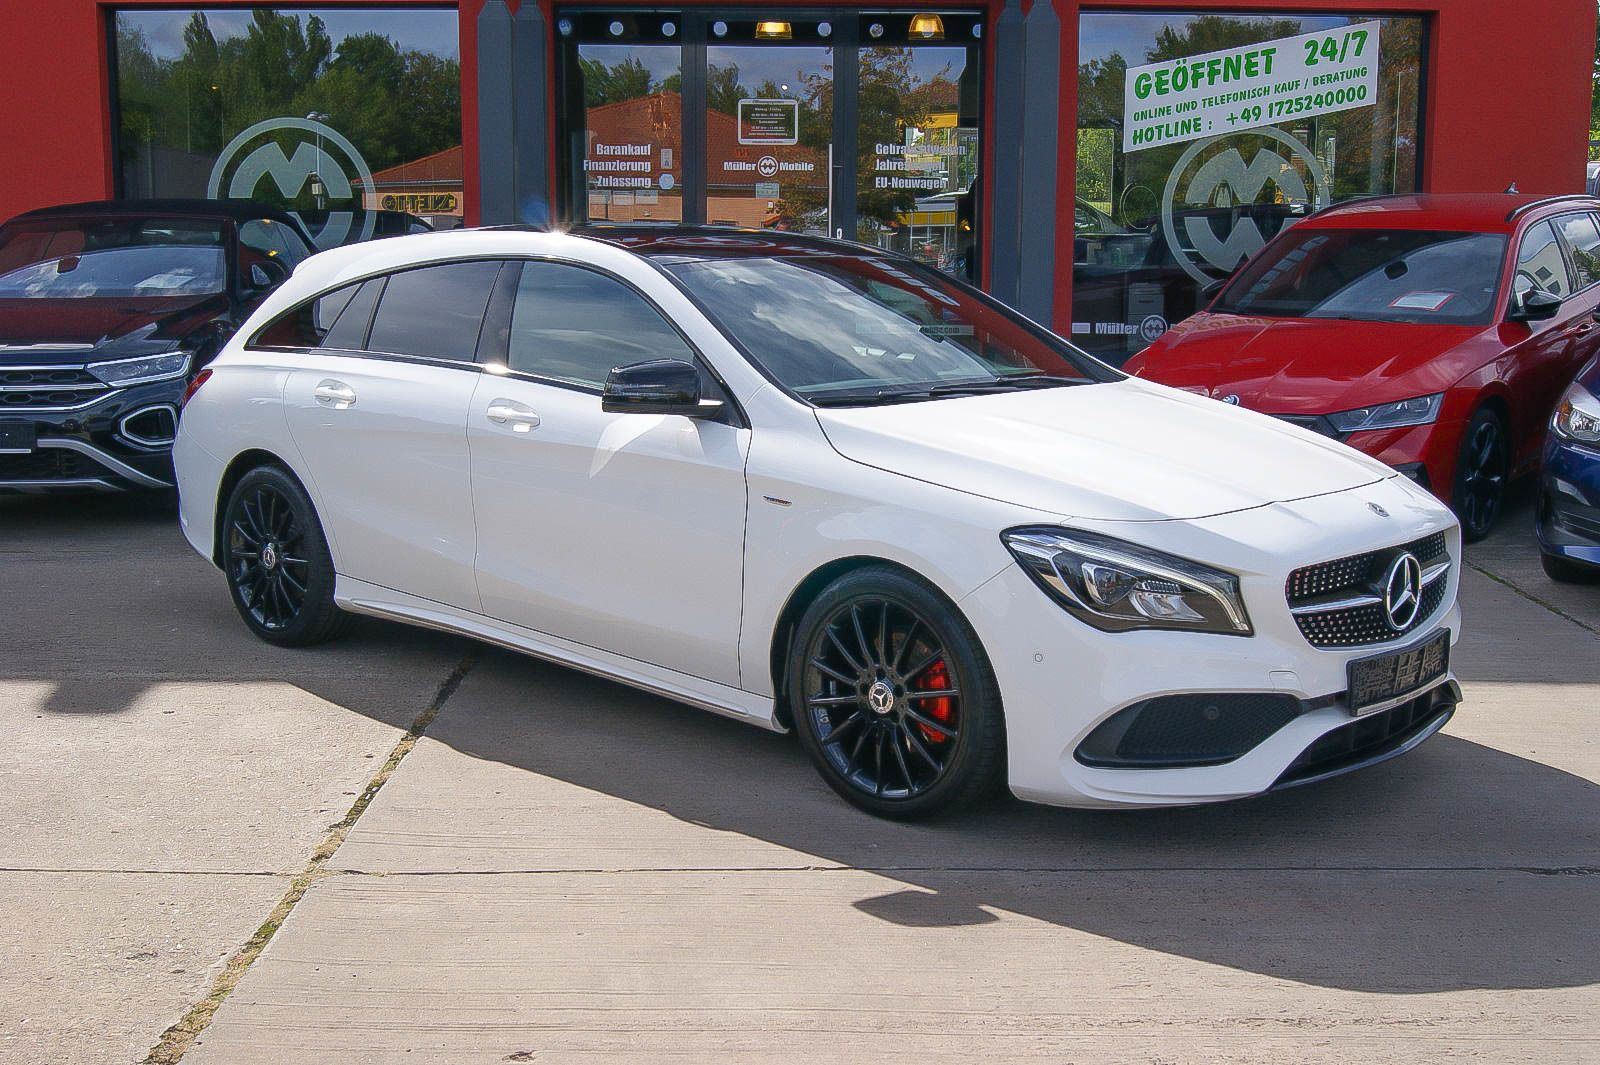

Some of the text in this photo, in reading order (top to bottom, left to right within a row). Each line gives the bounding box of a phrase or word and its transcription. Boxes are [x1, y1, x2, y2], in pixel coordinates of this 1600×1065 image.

[1135, 30, 1368, 99] GEÖFFNET 24/7
[1134, 105, 1172, 121] ONLINE
[1175, 101, 1198, 113] UND
[1202, 86, 1270, 108] TELEFONISCH
[1274, 80, 1300, 94] KAUF
[1313, 67, 1367, 86] BERATUNG
[1133, 117, 1202, 145] HOTLINE
[1226, 105, 1262, 125] +49
[1268, 85, 1367, 118] 1725240000
[596, 143, 651, 156] Barankauf
[875, 143, 965, 155] Gebrahtwan
[583, 160, 651, 172] Finanzierung
[723, 162, 814, 171] Müller Mobile
[597, 176, 652, 188] Zulassung
[875, 176, 947, 189] EU-Neuwagen
[1095, 322, 1139, 334] Müller
